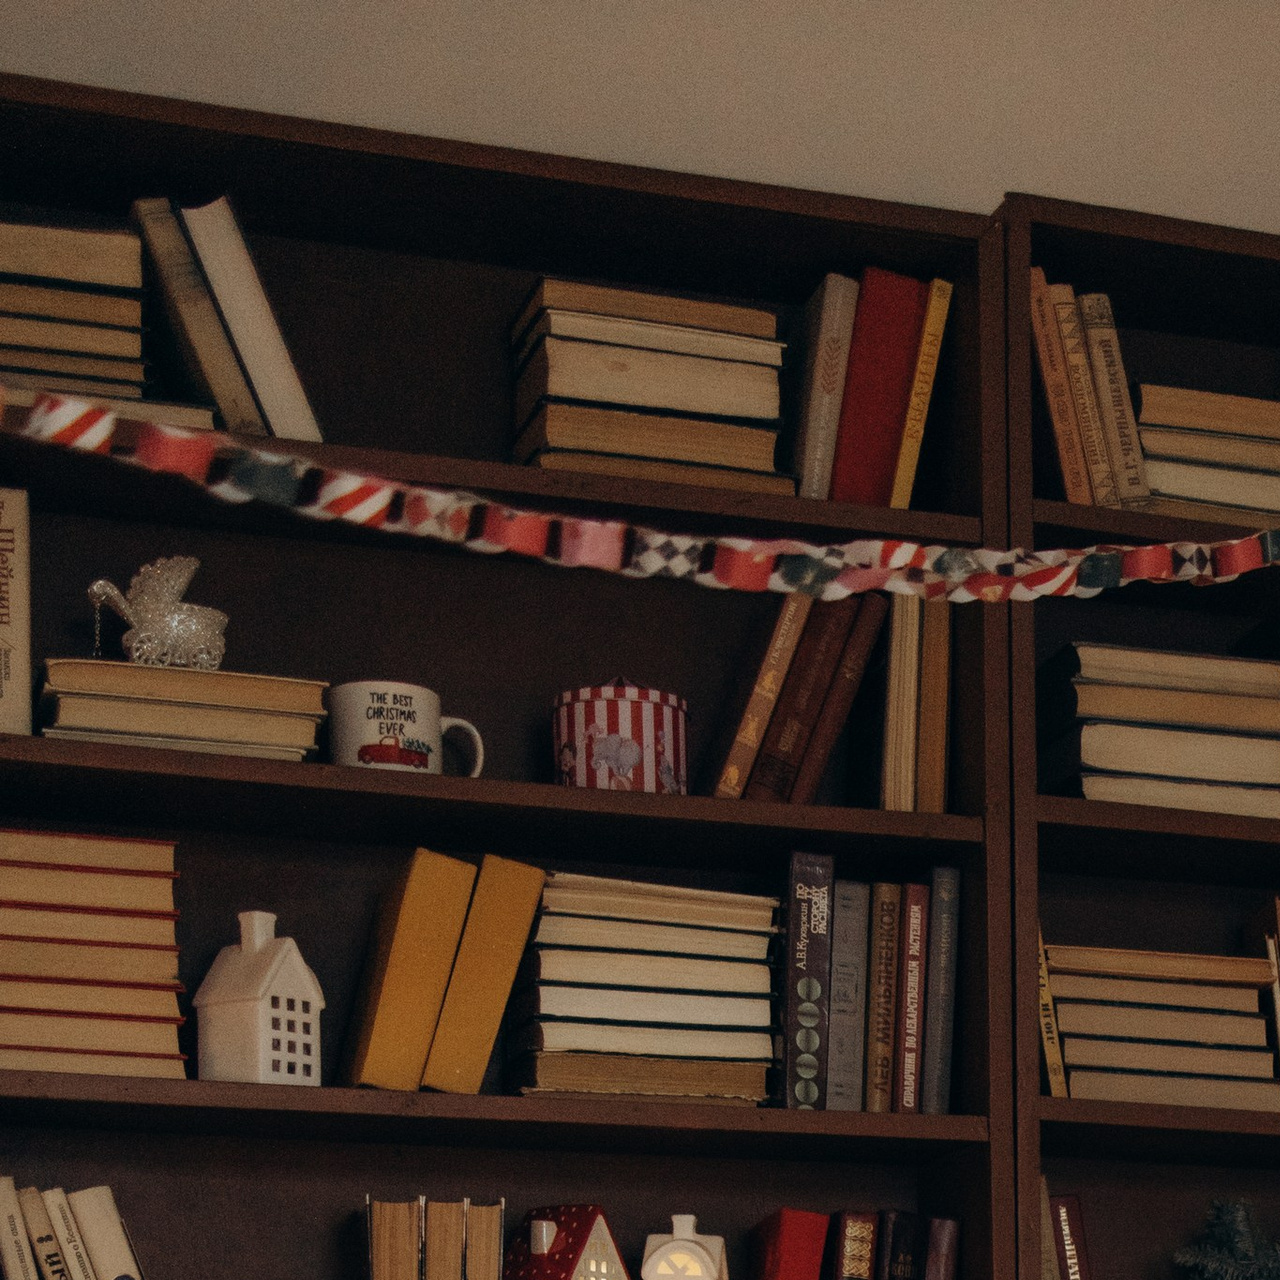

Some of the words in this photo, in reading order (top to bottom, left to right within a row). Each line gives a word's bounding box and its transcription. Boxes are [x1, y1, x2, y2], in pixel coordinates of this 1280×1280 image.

[1098, 337, 1134, 457] ЧЕРНЫШЕВСКИЙ
[366, 706, 417, 723] CHRISTMAS
[370, 692, 388, 704] THE
[393, 694, 413, 708] BEST
[379, 722, 406, 737] EVER
[906, 904, 923, 956] РАСТЕНИЯМ
[902, 959, 922, 1035] ЛЕКАРСТВЕННЫМ
[903, 1035, 917, 1048] ПО
[873, 1055, 891, 1093] ЛЕВ
[900, 1051, 918, 1107] СПРАВОЧНИК
